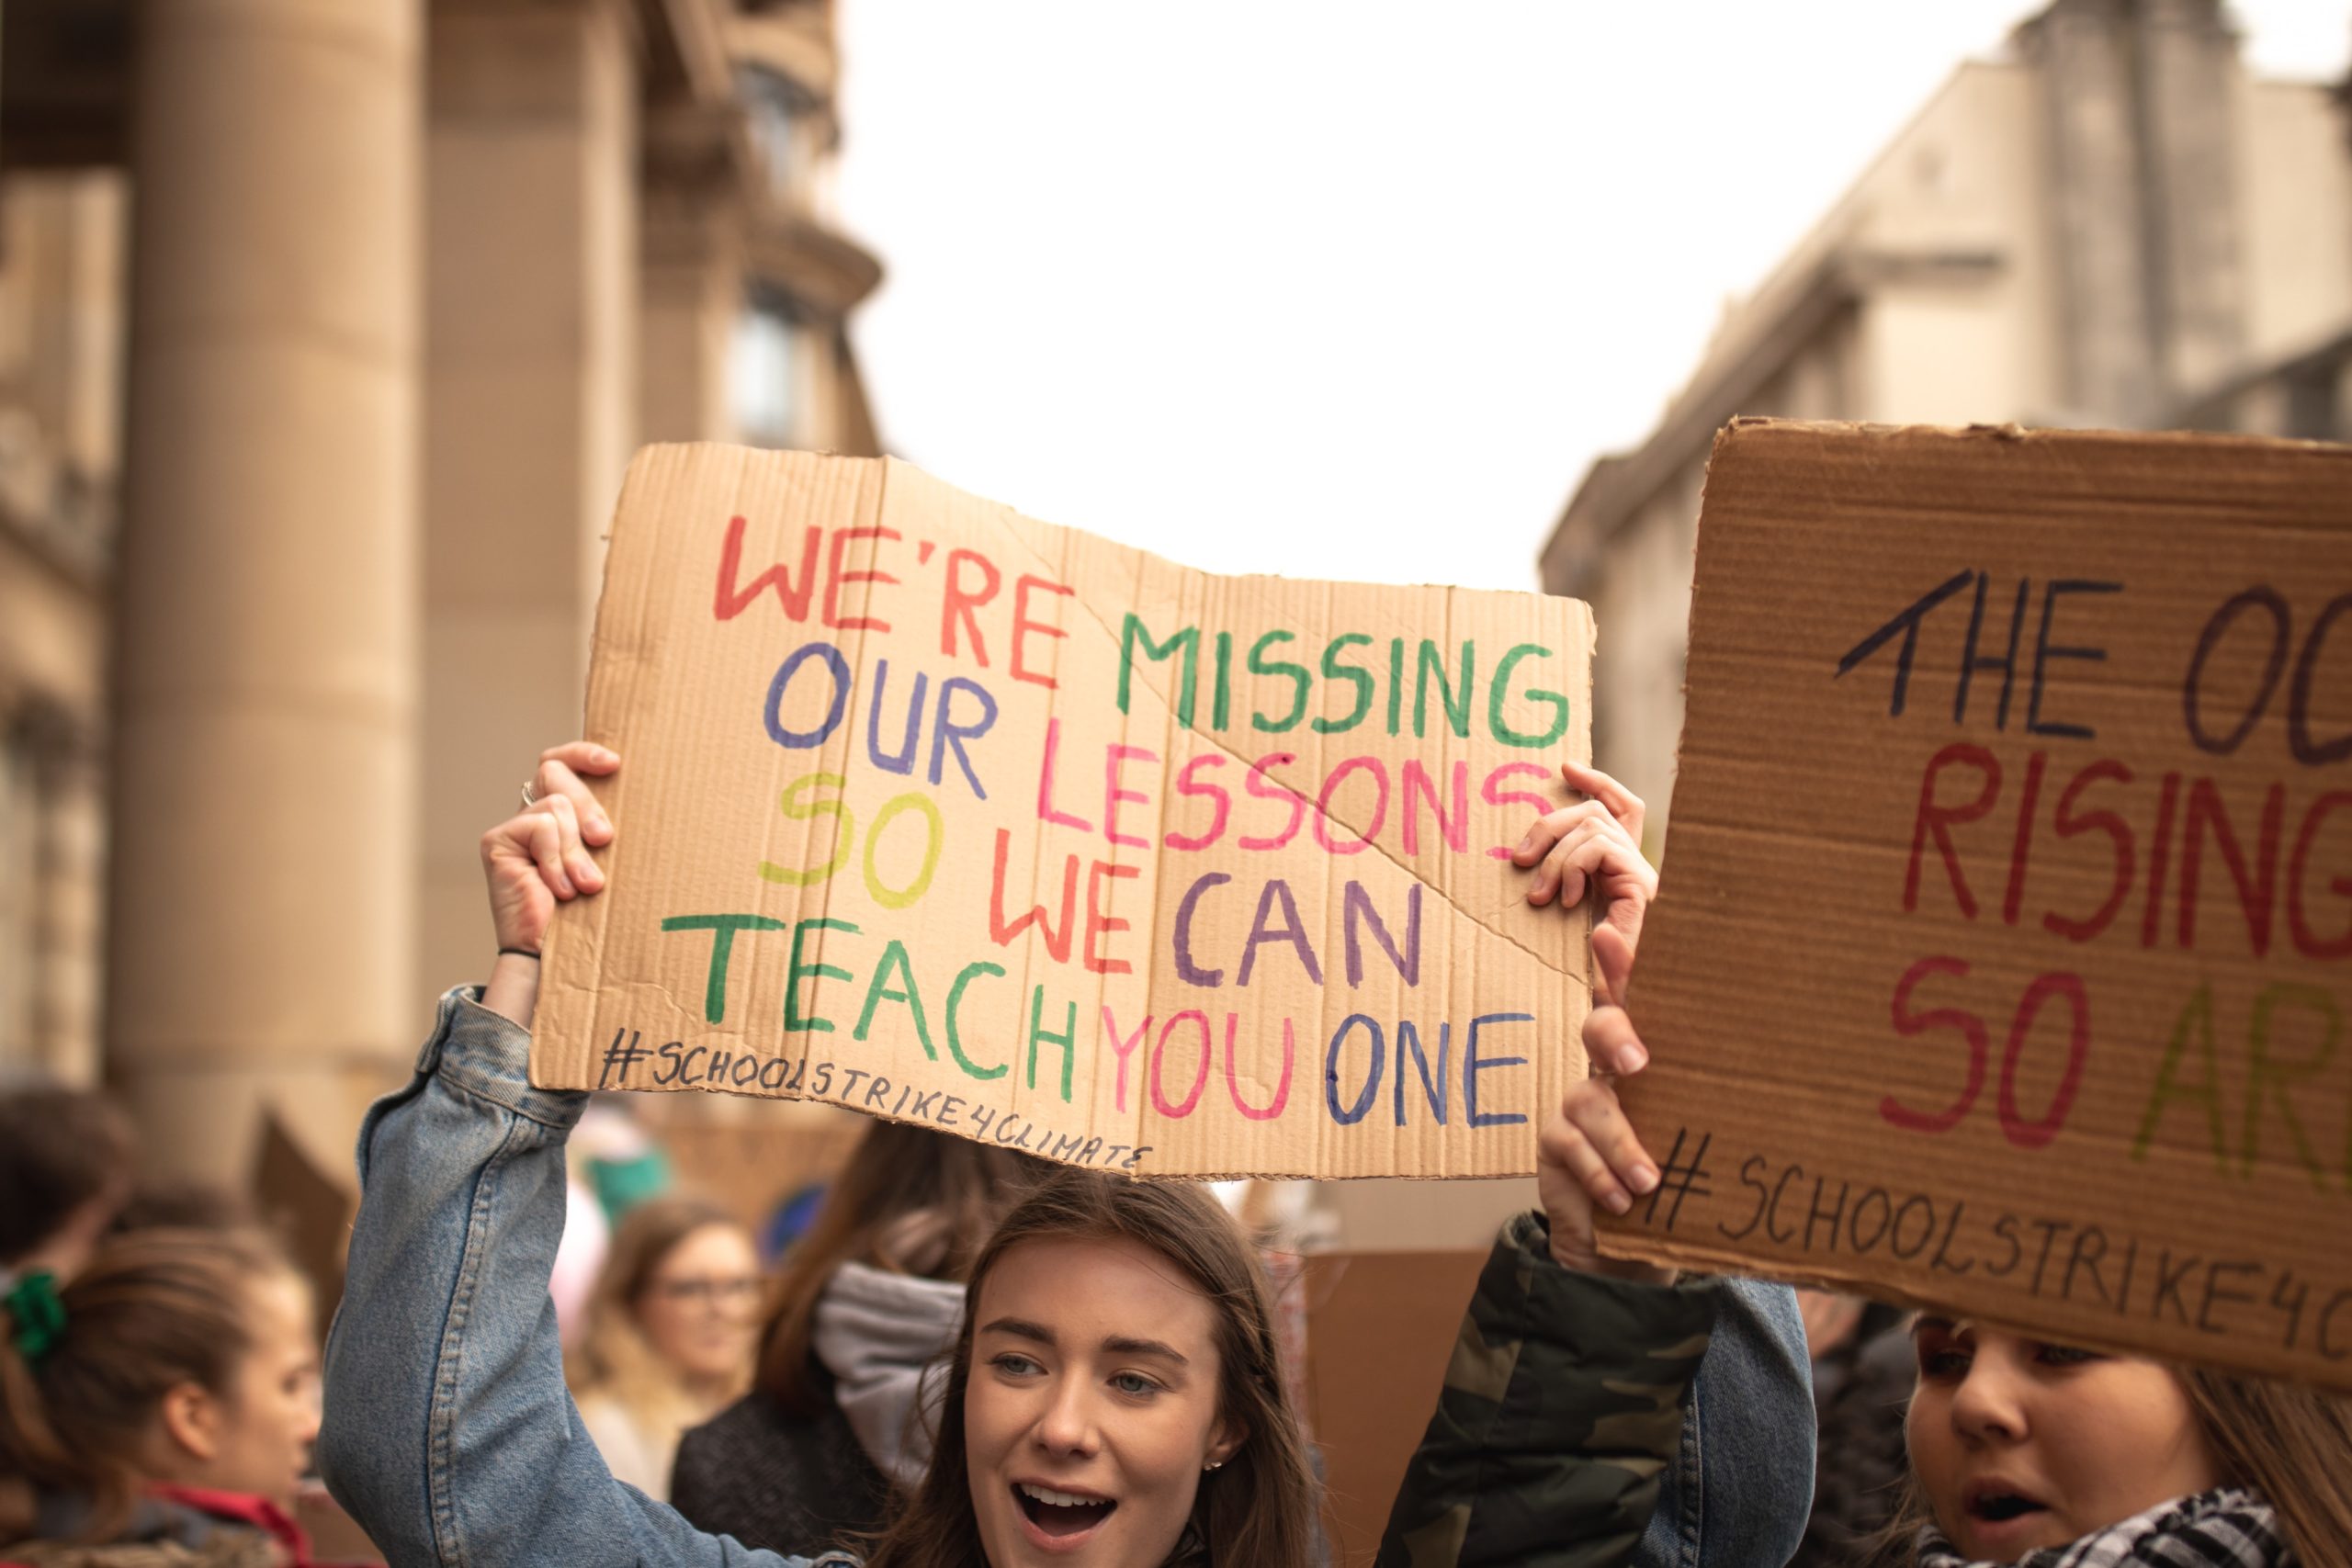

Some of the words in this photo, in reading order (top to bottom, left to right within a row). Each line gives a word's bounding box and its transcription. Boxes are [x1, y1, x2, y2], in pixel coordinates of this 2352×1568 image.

[713, 514, 1076, 690] WE'RE
[1115, 611, 1570, 749] MISSING
[1834, 567, 2125, 740] THE
[763, 641, 999, 800] OUR
[1037, 716, 1556, 862] LESSONS
[1902, 741, 2352, 960] RISING
[757, 772, 944, 909] SO
[989, 828, 1142, 975] WE
[1171, 872, 1423, 989] CAN
[661, 913, 1077, 1104] TEACH
[1102, 1005, 1295, 1121] YOU
[1325, 1012, 1535, 1128] ONE
[1879, 954, 2091, 1149] SO
[2129, 979, 2352, 1195] AR
